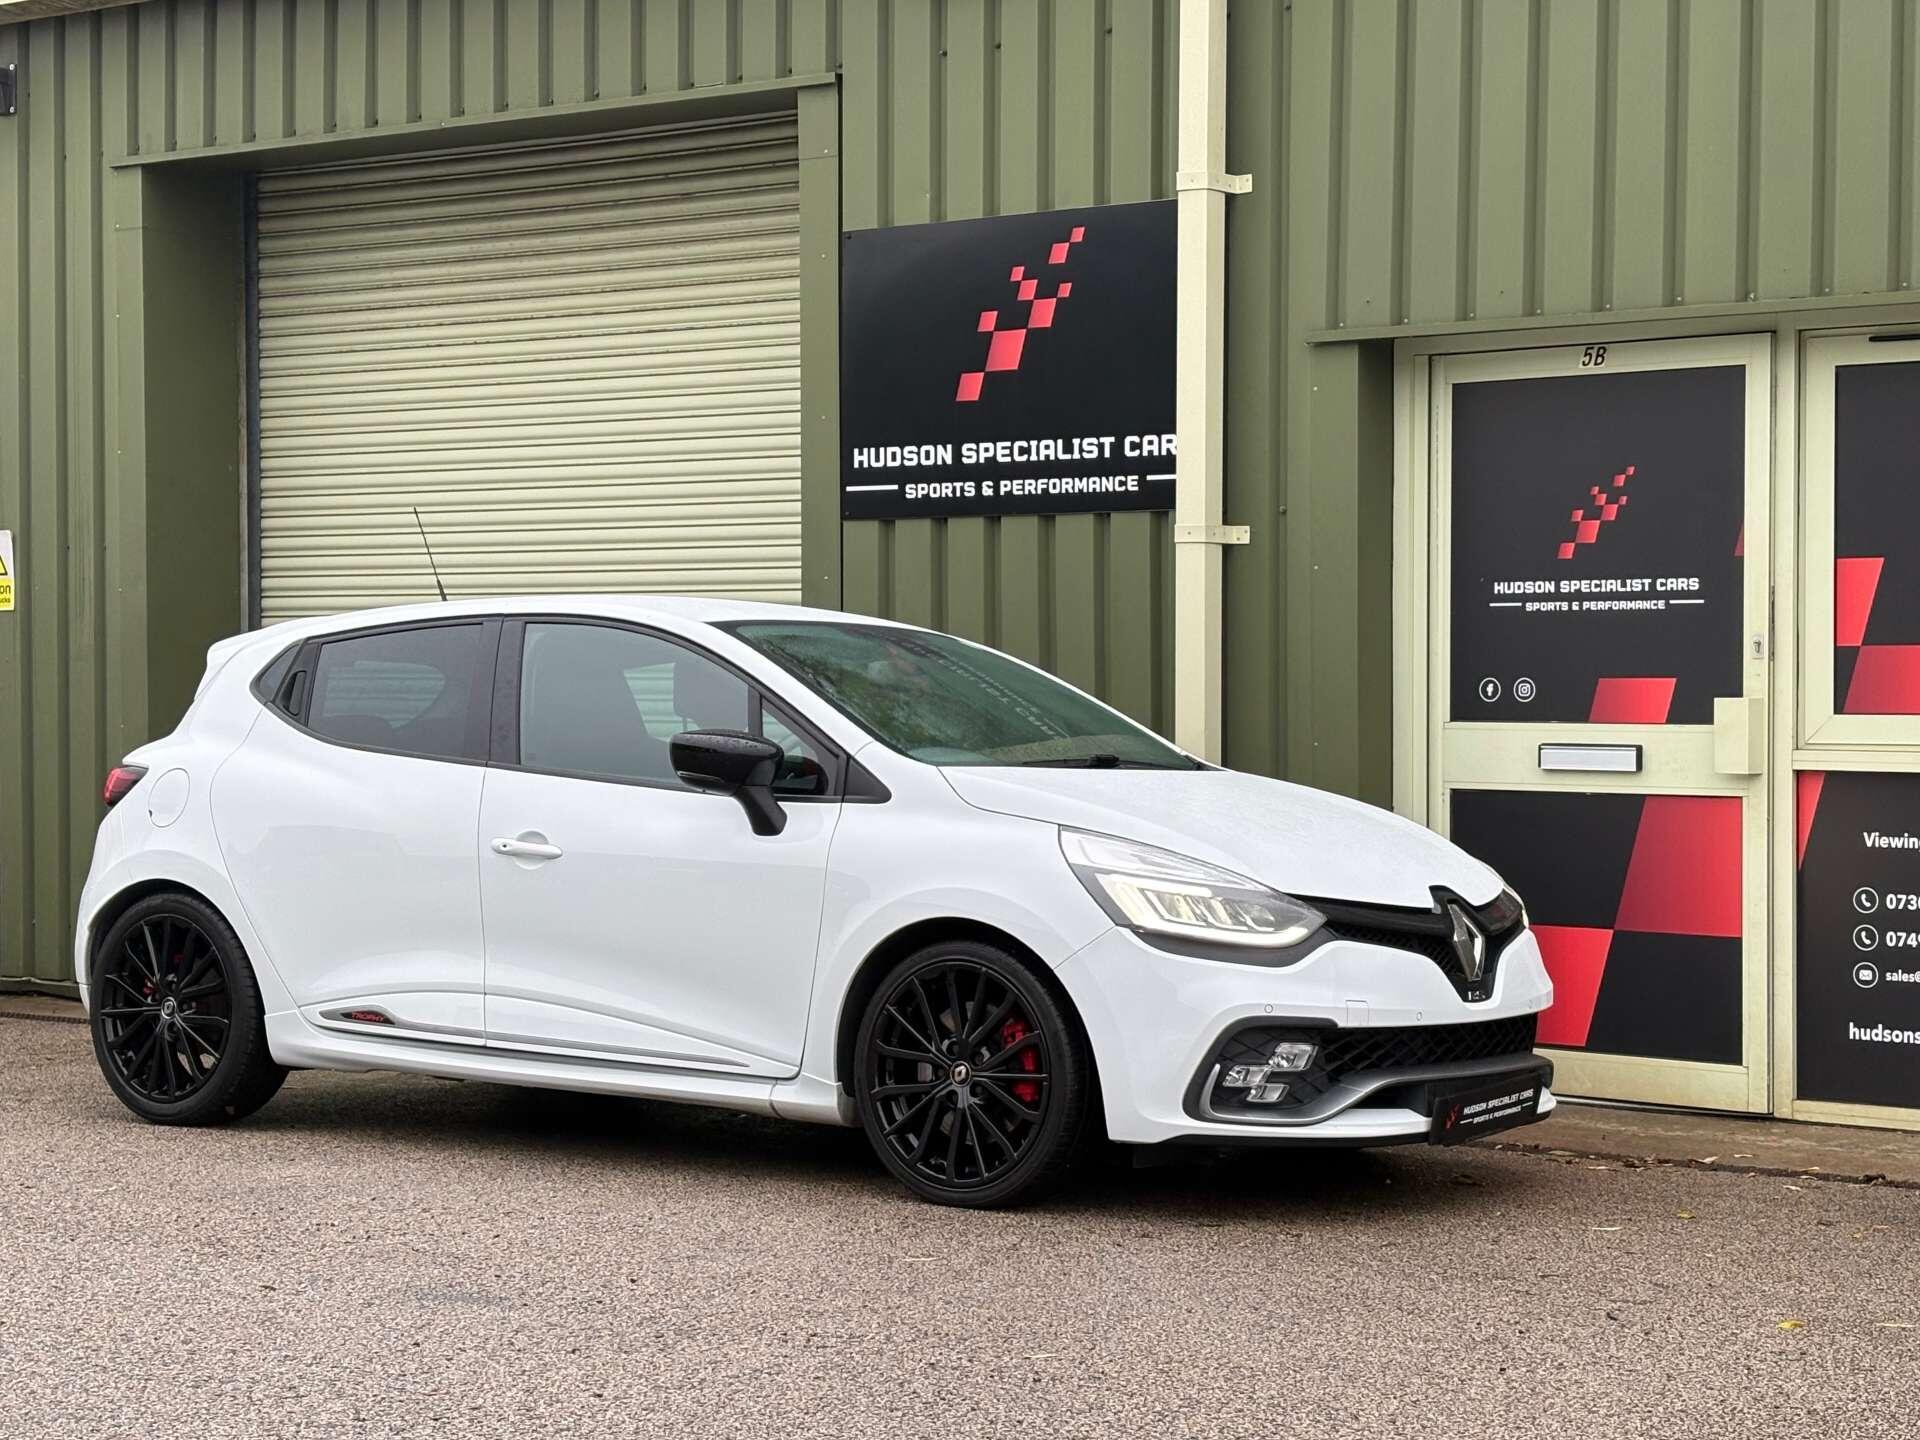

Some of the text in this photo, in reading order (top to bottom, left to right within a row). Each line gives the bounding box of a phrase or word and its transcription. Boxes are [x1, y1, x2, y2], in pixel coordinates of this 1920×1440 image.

[1582, 346, 1607, 366] 5B
[853, 433, 1177, 468] HUDSON SPECIALIST CAR
[905, 475, 1139, 499] SPORTS & PERFORMANCE
[1494, 577, 1700, 594] HUDSON SPECIALIST CARS
[1525, 600, 1666, 612] SPORTS & PERFORMANCE
[1863, 831, 1920, 852] Viewin
[1886, 893, 1920, 911] 073
[1886, 931, 1920, 948] 074
[1464, 1089, 1534, 1115] HUDSON SPECIALIST CARS
